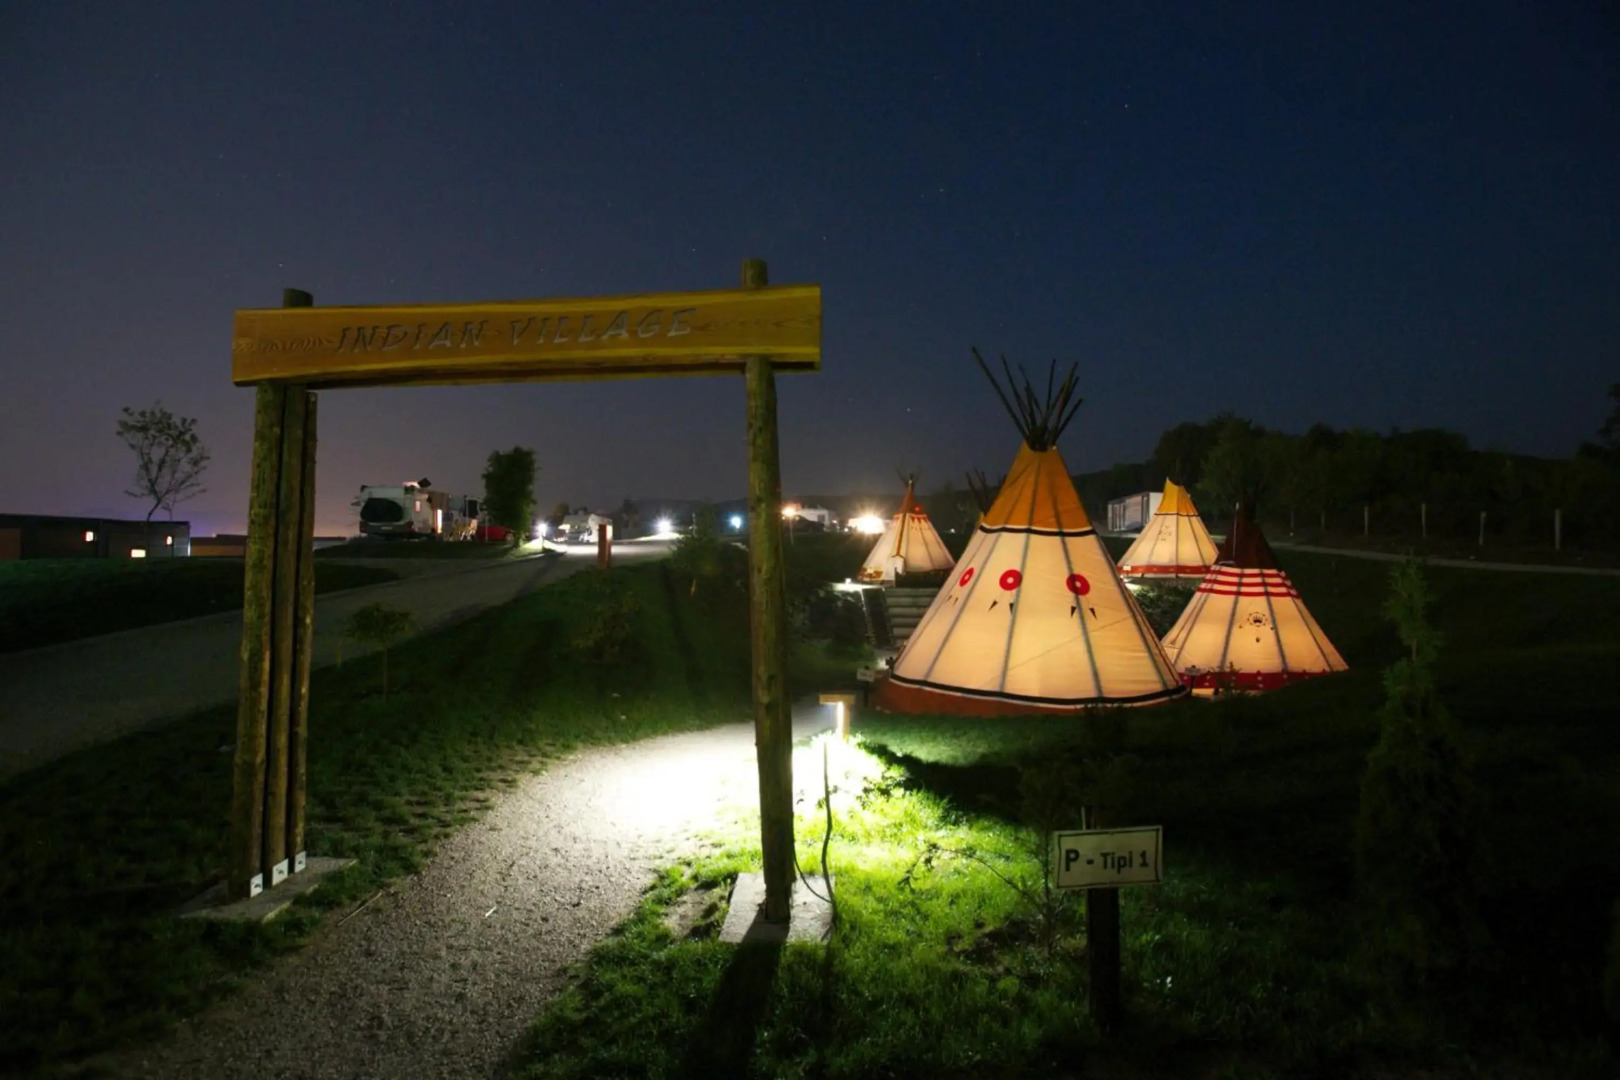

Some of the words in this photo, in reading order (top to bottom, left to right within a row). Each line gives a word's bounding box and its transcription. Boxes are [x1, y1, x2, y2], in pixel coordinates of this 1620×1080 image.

[337, 320, 488, 353] INDIAN
[510, 308, 697, 346] VILLAGE
[1065, 849, 1080, 872] P
[1139, 850, 1149, 867] 1
